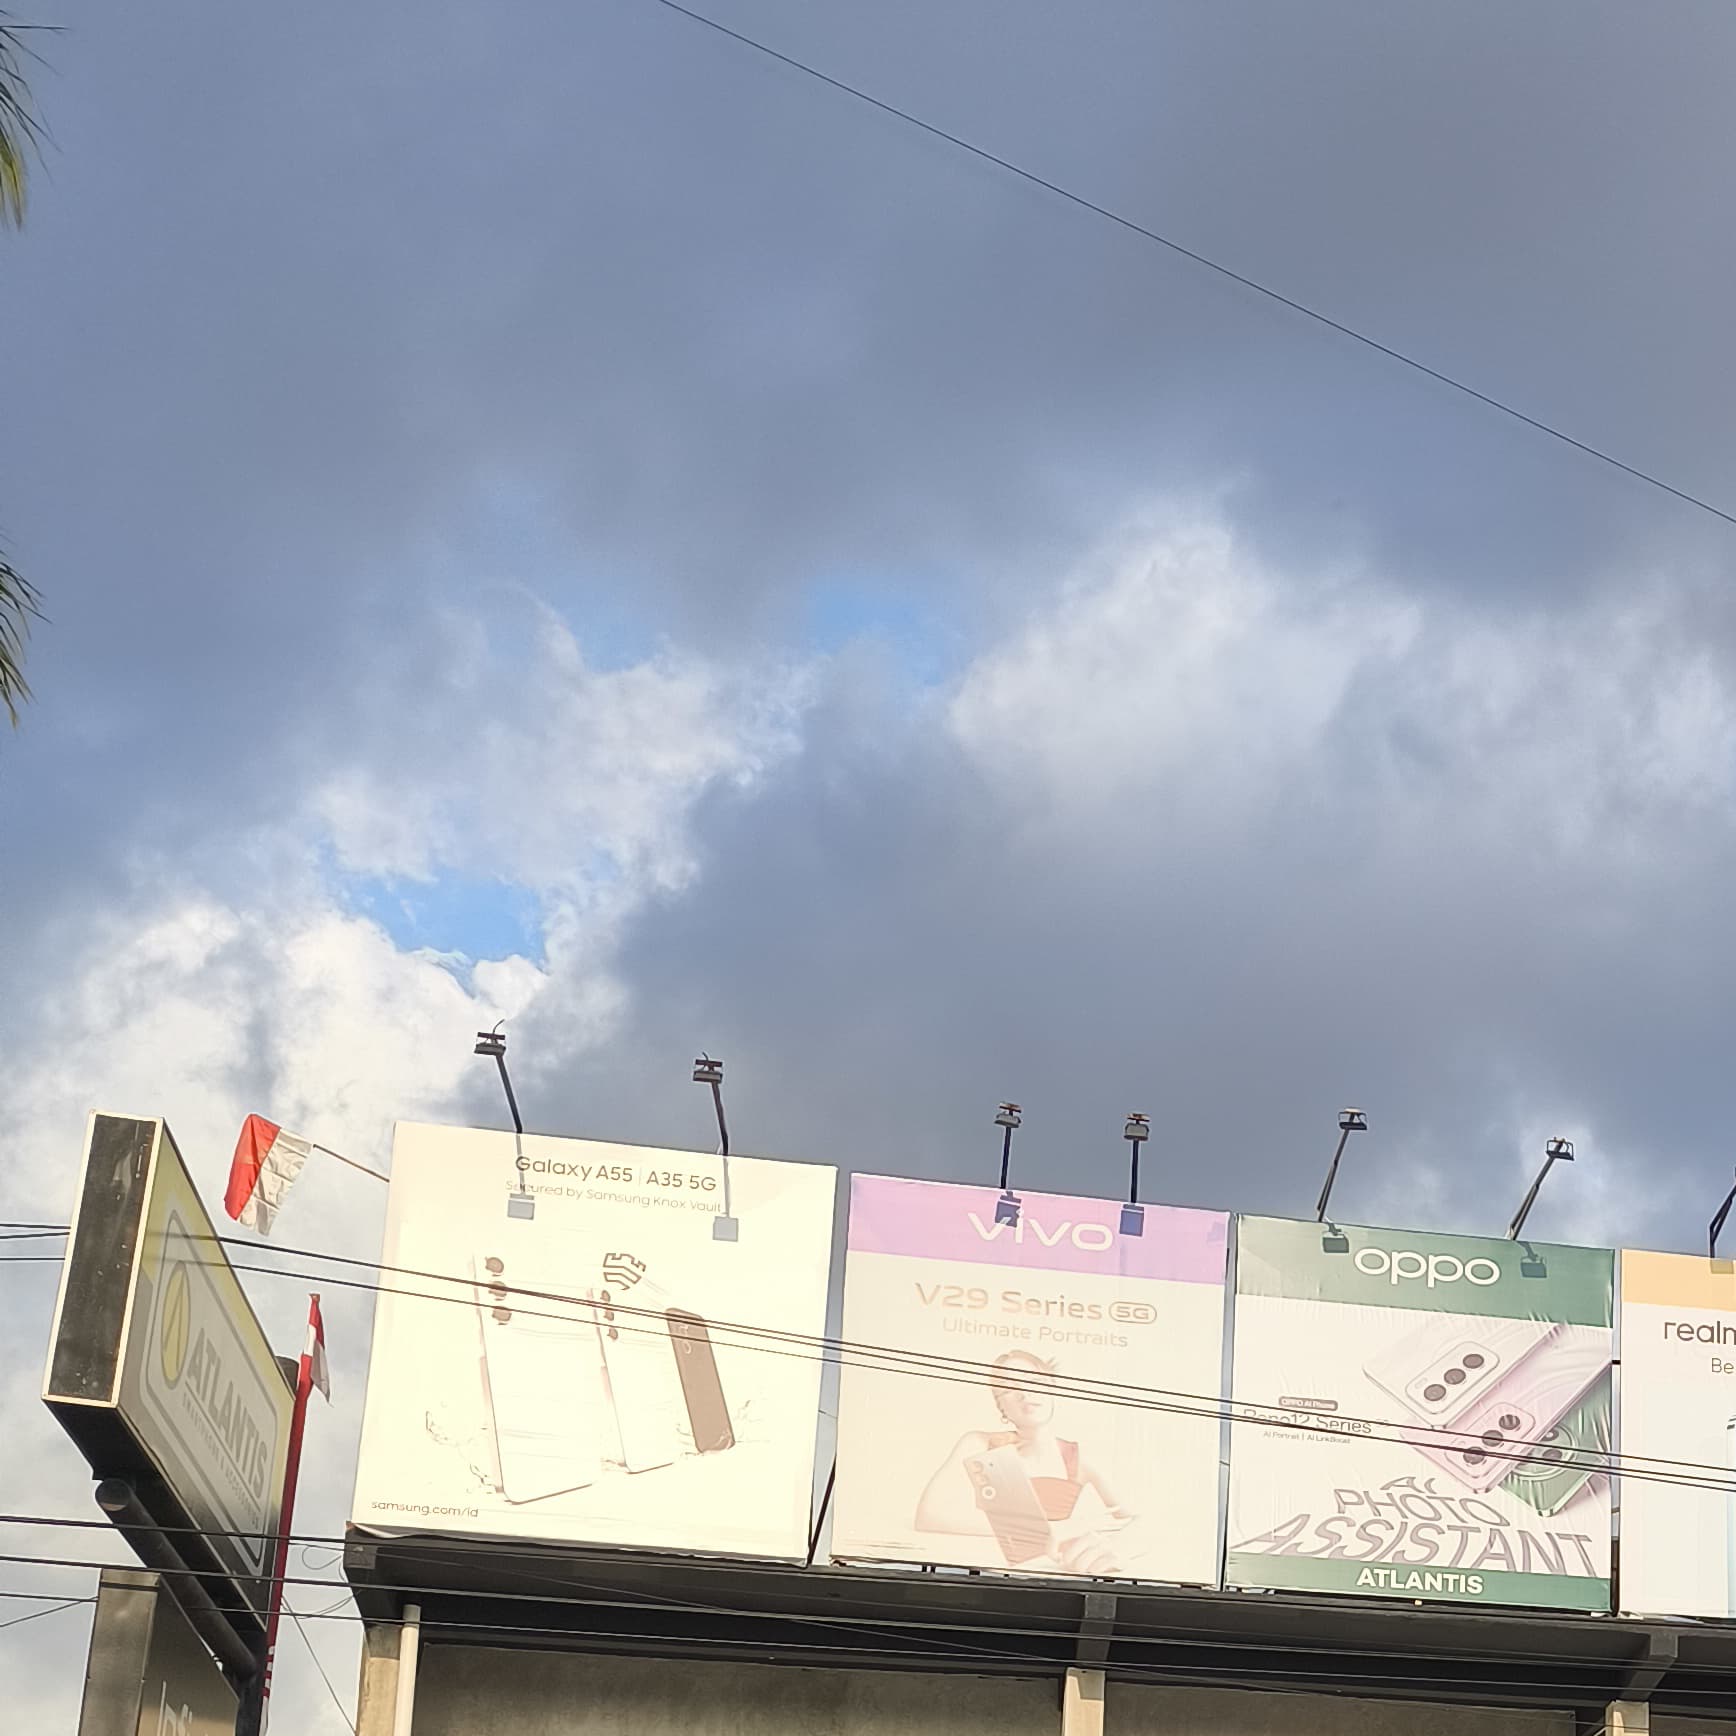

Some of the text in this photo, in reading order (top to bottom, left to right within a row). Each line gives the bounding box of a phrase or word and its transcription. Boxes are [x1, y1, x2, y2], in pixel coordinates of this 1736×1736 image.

[516, 1156, 716, 1190] Galaxy A55 A35 5G
[566, 1188, 582, 1200] by
[587, 1189, 650, 1207] Samsung
[654, 1196, 685, 1208] Knox
[690, 1200, 721, 1212] Vault
[968, 1207, 1113, 1251] vivo
[1354, 1248, 1501, 1288] oppo
[915, 1283, 1149, 1320] V29 Series 5G
[943, 1317, 1128, 1348] Ultimate Portraits
[1711, 1358, 1735, 1375] Be
[187, 1327, 267, 1499] ATLANTIS
[371, 1501, 479, 1519] samsung.com/id
[1334, 1488, 1510, 1526] PHOTO
[1231, 1513, 1597, 1577] ASSISTANT
[1356, 1567, 1484, 1594] ATLANTIS
